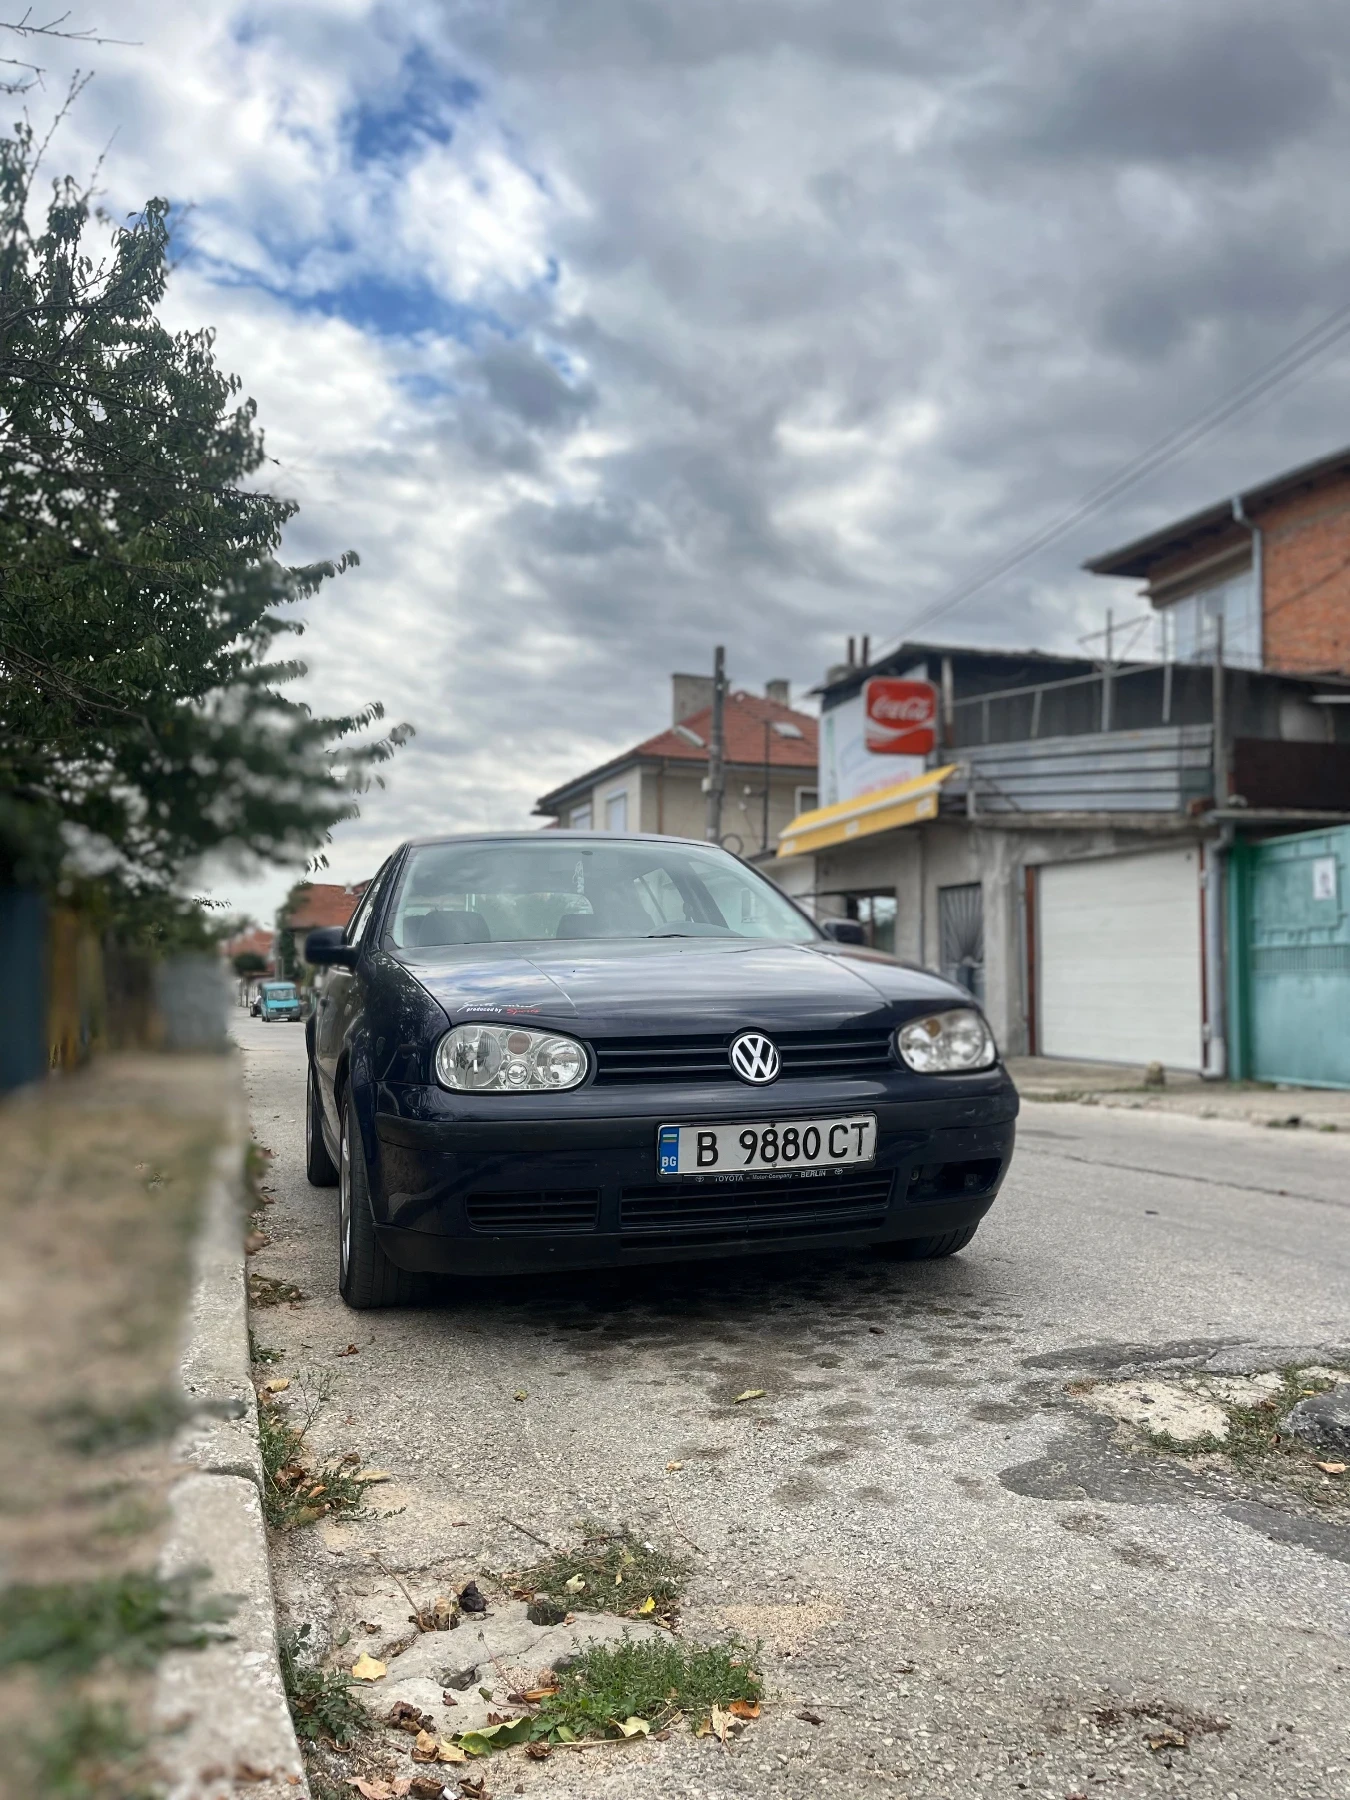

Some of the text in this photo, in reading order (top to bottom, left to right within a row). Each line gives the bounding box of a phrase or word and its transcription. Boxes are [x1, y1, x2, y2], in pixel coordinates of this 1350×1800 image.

[696, 1121, 870, 1168] B 9880 CT
[661, 1156, 677, 1167] BG
[715, 1174, 744, 1183] TOYOTA
[800, 1169, 826, 1179] BERLIN
